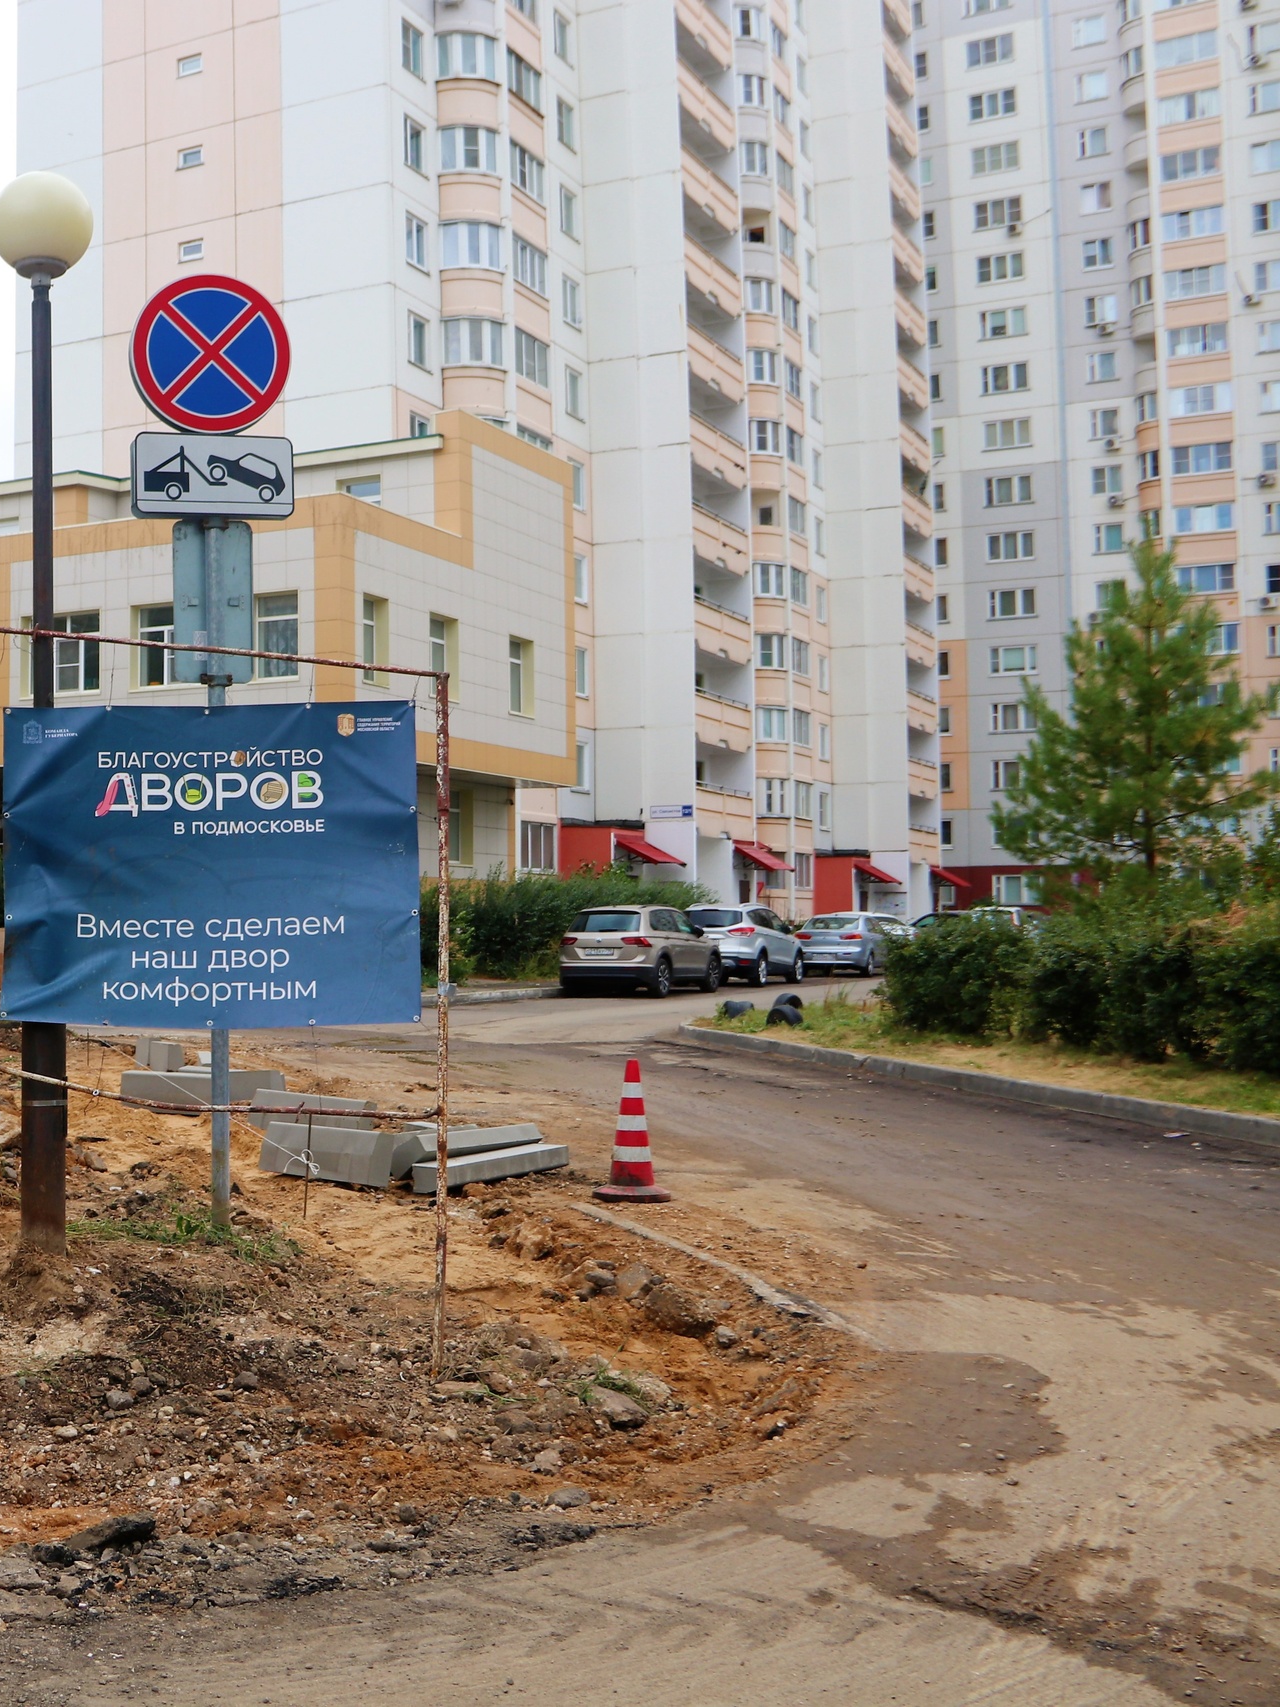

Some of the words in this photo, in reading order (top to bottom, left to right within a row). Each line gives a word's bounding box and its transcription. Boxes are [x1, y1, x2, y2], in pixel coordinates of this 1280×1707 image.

[94, 770, 325, 818] ДВОРОВ
[173, 821, 185, 835] В
[192, 819, 325, 836] ПОДМОСКОВЬЕ
[76, 913, 195, 939] Вместе
[204, 915, 345, 941] сделаем
[131, 950, 197, 969] наш
[207, 948, 290, 973] двор
[103, 976, 317, 1007] комфортным
